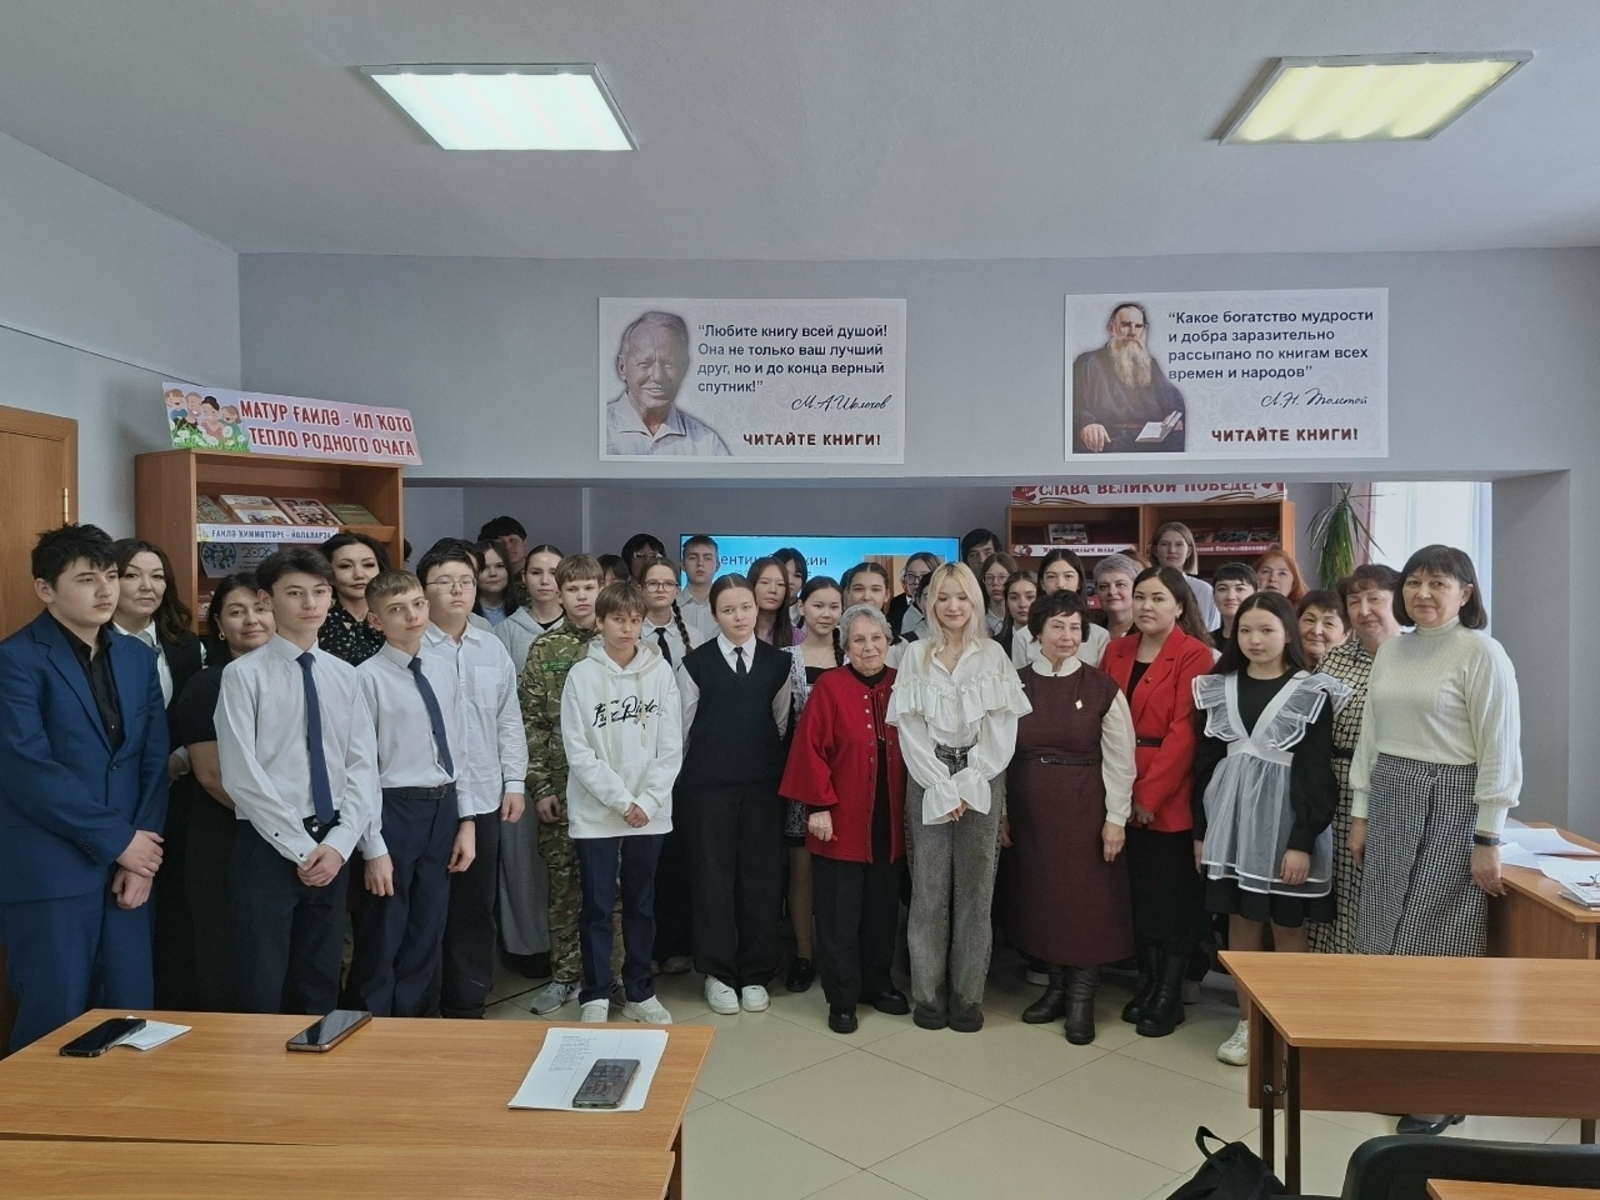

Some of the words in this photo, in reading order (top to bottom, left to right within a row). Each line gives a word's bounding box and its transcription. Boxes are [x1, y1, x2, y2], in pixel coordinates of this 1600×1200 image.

[1222, 310, 1298, 324] богатство
[1301, 310, 1374, 325] мудрости
[761, 326, 799, 341] книгу
[801, 324, 834, 338] всей
[836, 324, 888, 341] душой!
[1168, 332, 1178, 344] и
[1180, 328, 1228, 345] добра
[1231, 330, 1336, 345] заразительно
[697, 342, 725, 356] Она
[728, 345, 745, 356] не
[747, 345, 796, 356] только
[798, 345, 826, 356] ваш
[829, 342, 884, 359] лучший
[1168, 350, 1253, 365] рассыпано
[1255, 349, 1275, 360] по
[1278, 349, 1330, 360] книгам
[1334, 347, 1369, 359] всех
[696, 364, 731, 377] друг,
[734, 364, 752, 374] но
[754, 364, 764, 374] и
[765, 364, 785, 376] до
[786, 364, 828, 376] конца
[830, 361, 885, 377] верный
[1166, 369, 1224, 385] времен
[1227, 368, 1238, 379] и
[239, 400, 288, 422] МАТУР
[353, 412, 374, 430] ИЛ
[248, 427, 298, 448] ТЕПЛО
[303, 430, 369, 453] РОДНОГО
[372, 438, 415, 457] ОЧАГА
[742, 431, 817, 446] ЧИТАЙТЕ
[822, 432, 881, 446] КНИГИ!
[1210, 426, 1290, 443] ЧИТАЙТЕ
[1295, 427, 1359, 442] КНИГИ!
[1039, 485, 1090, 496] СЛАВА
